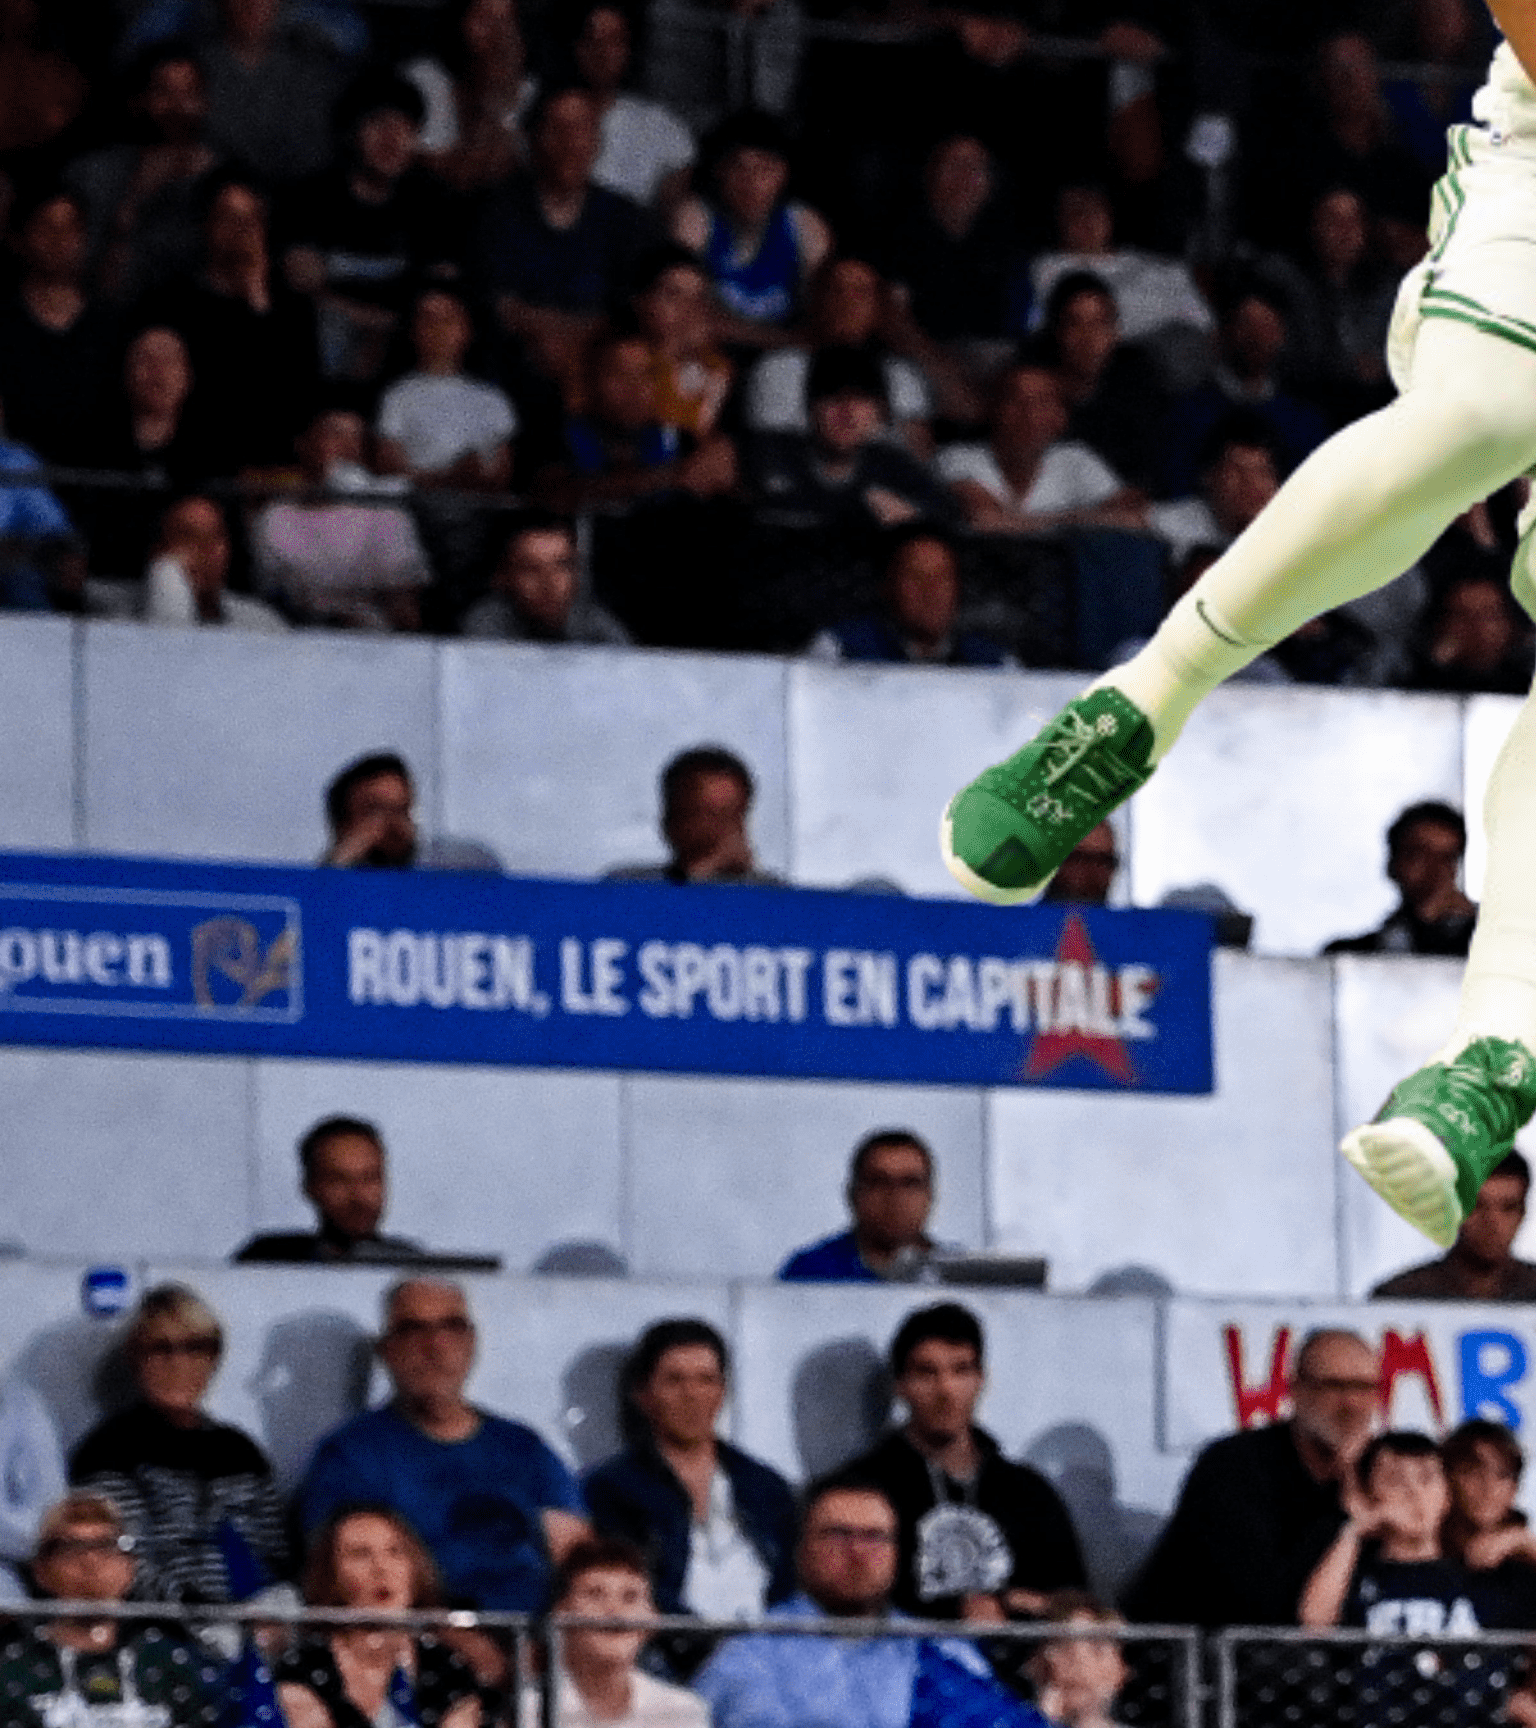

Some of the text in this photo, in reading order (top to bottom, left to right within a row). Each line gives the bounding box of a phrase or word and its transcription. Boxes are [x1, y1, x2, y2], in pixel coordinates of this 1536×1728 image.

[0, 927, 173, 988] ouen
[348, 928, 1158, 1040] ROUEN, LE SPORT EN CAPITALE
